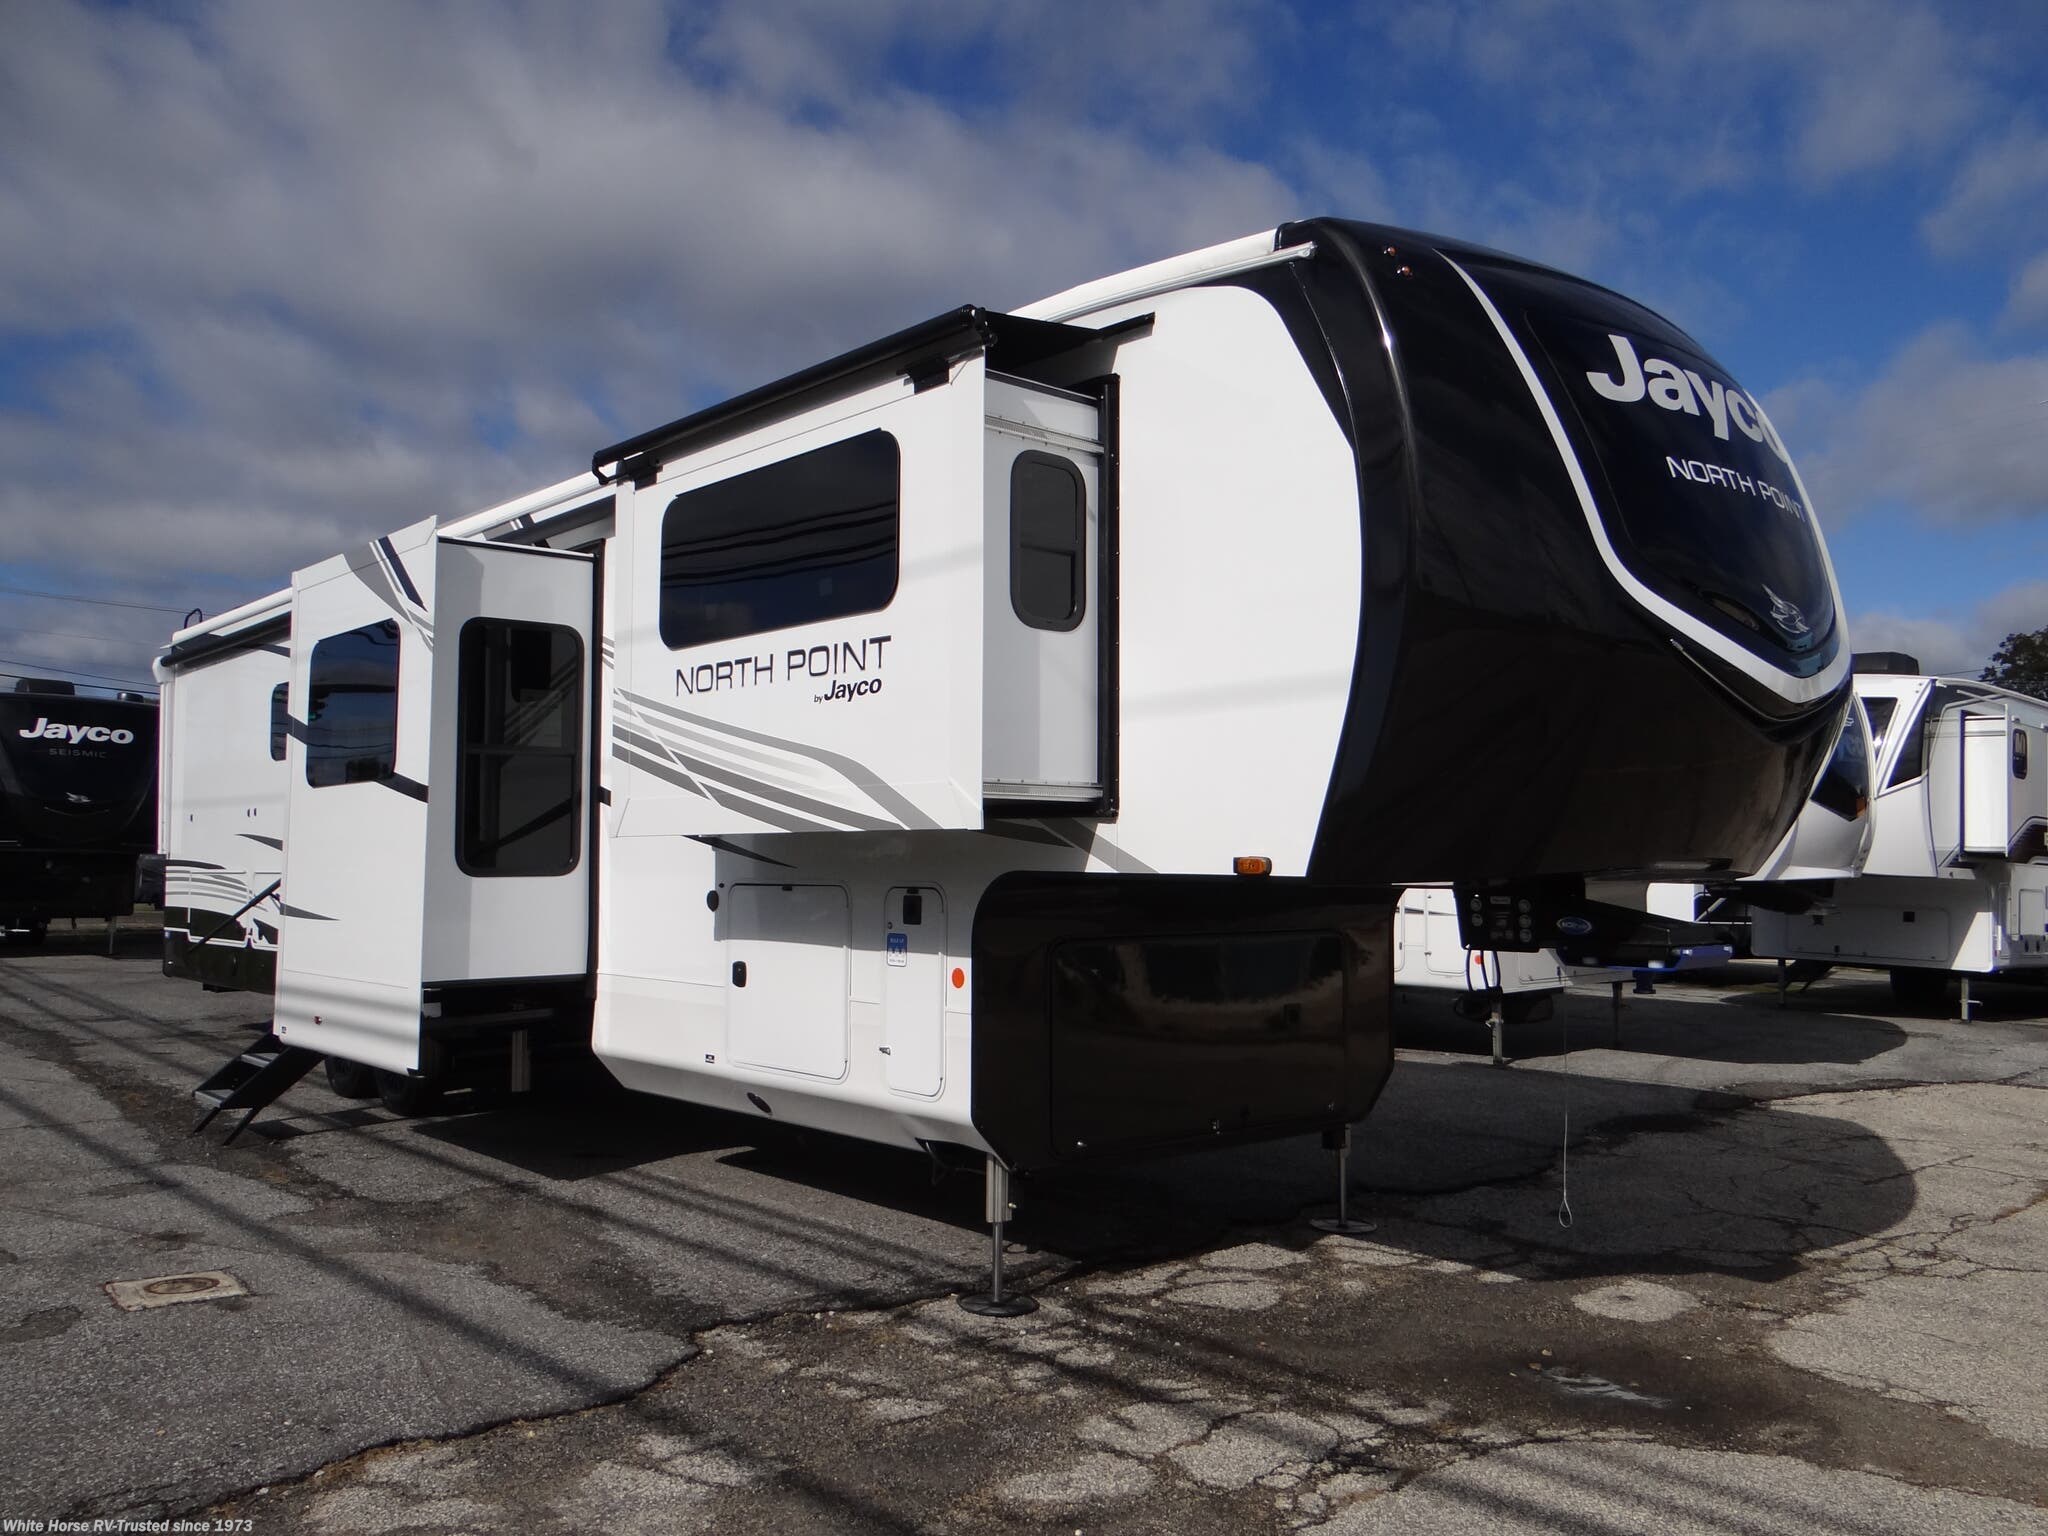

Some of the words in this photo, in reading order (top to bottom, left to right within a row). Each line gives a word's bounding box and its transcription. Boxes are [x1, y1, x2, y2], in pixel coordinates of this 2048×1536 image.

[1665, 456, 1756, 497] NORTH
[1757, 480, 1806, 522] POINT
[675, 653, 774, 697] NORTH
[786, 635, 892, 681] POINT
[813, 694, 823, 704] by
[823, 678, 882, 702] Jayco
[19, 717, 134, 744] Jayco
[49, 748, 107, 759] SEISMIC
